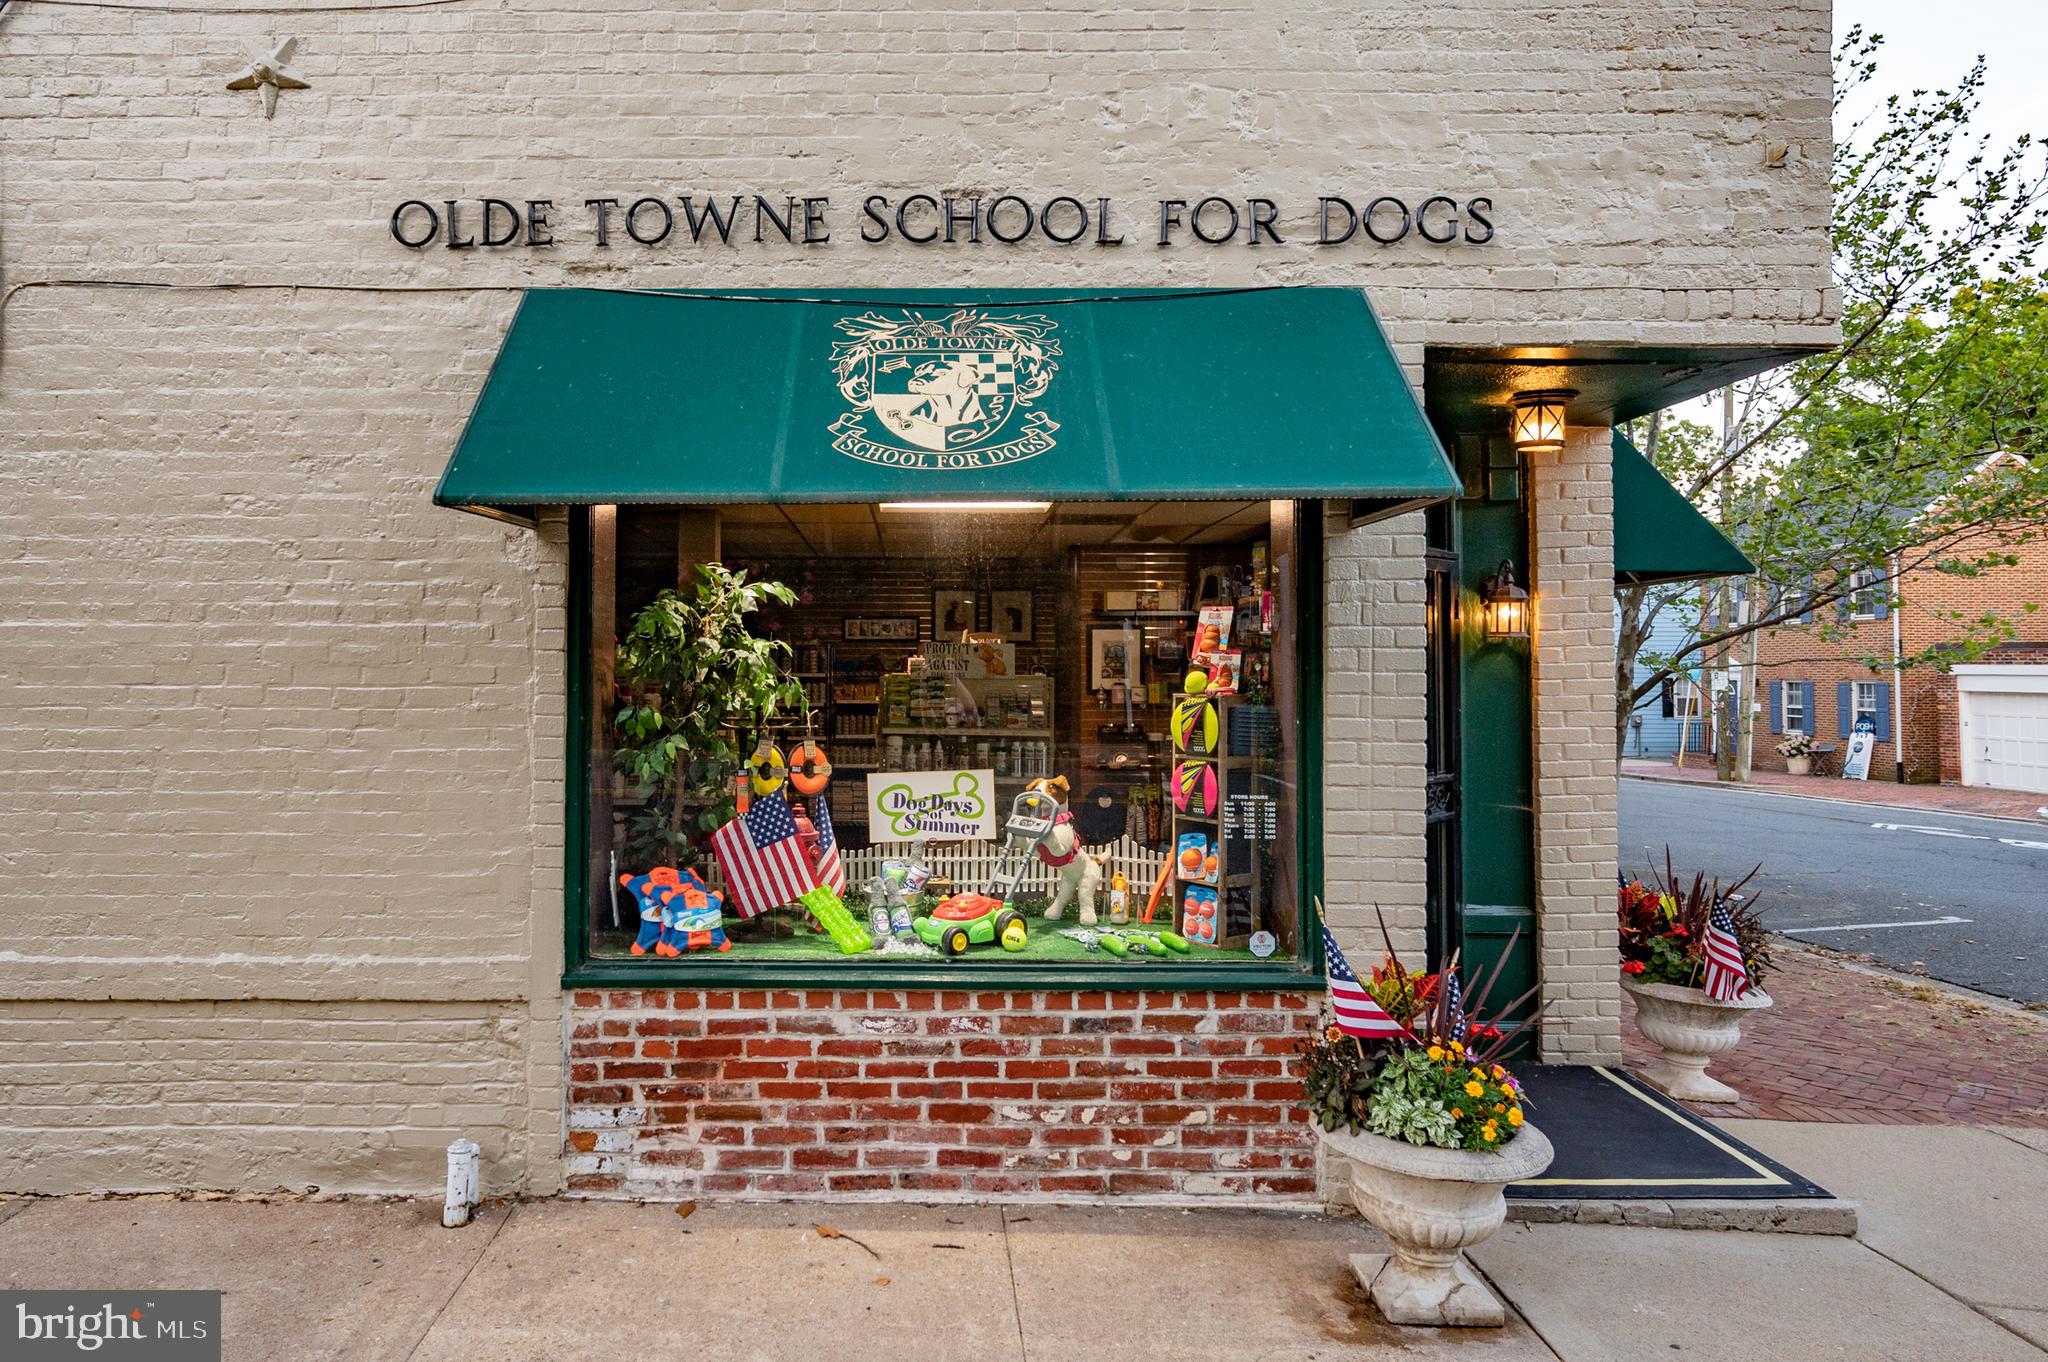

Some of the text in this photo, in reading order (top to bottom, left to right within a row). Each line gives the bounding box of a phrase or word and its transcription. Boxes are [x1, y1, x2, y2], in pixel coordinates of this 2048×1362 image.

[391, 194, 1495, 248] OLDE TOWNE SCHOOL FOR DOGS
[875, 336, 1009, 351] OLDE TOWNE
[840, 435, 1048, 468] SCHOOL FOR DOGS
[893, 792, 973, 819] Dog Days
[930, 809, 944, 820] of
[904, 813, 980, 836] Summer
